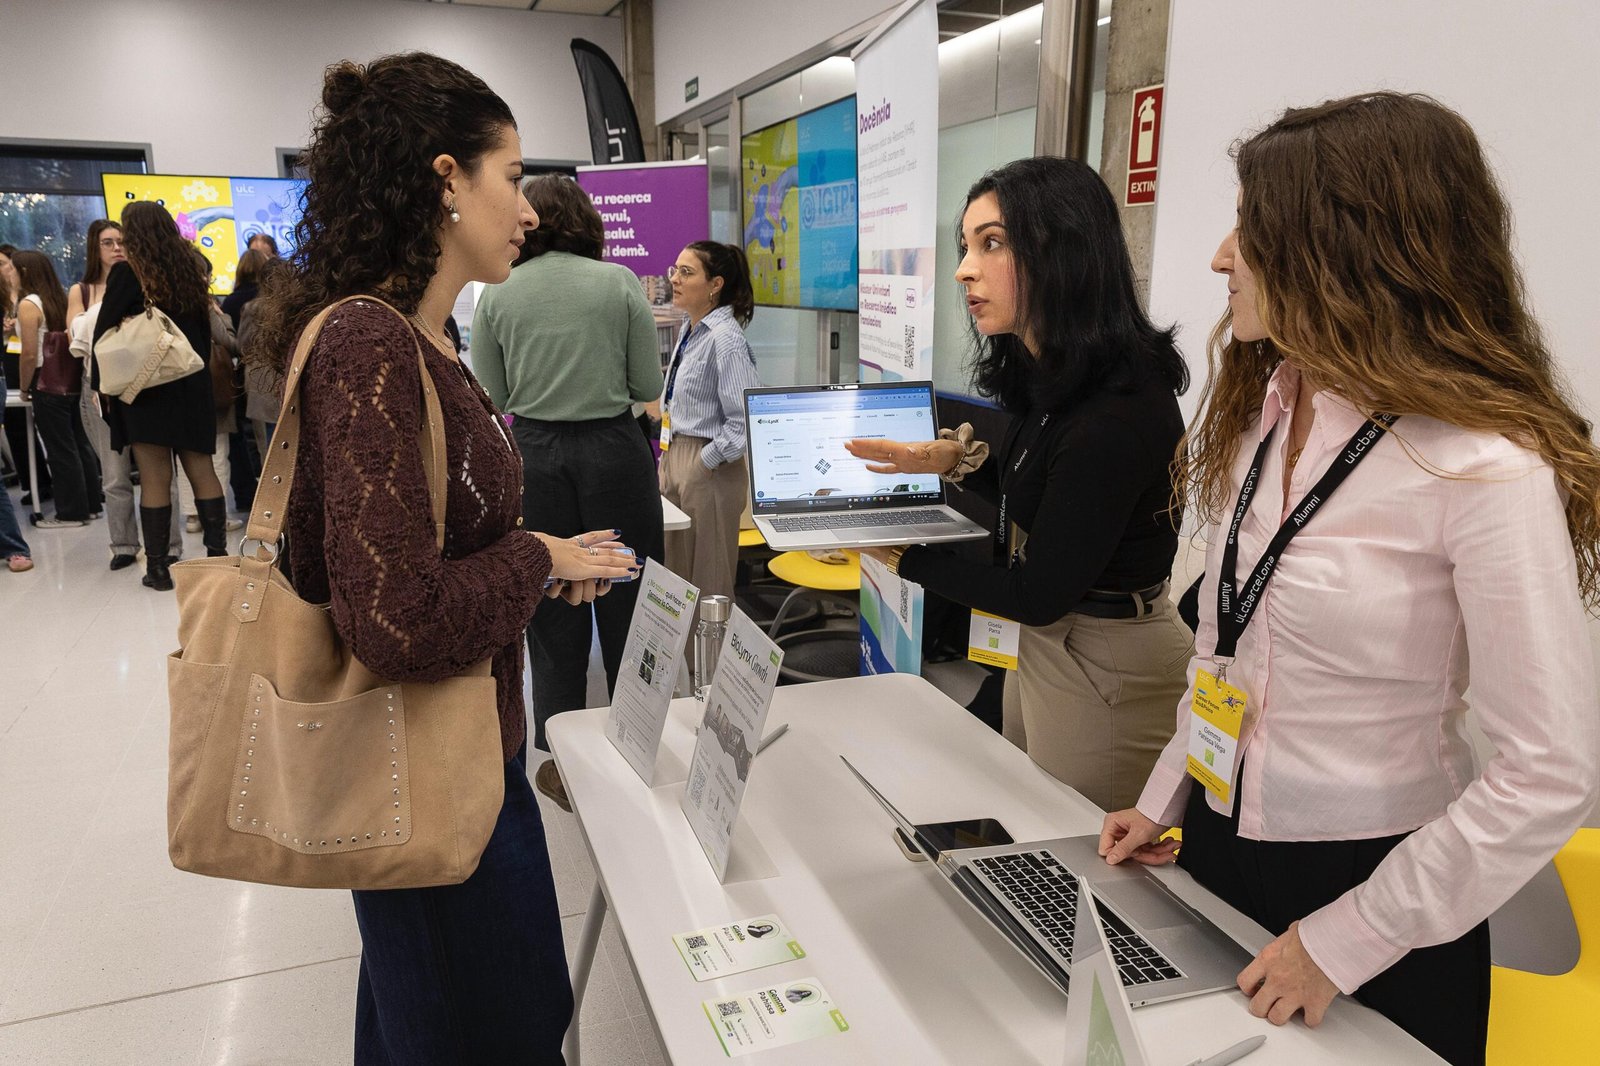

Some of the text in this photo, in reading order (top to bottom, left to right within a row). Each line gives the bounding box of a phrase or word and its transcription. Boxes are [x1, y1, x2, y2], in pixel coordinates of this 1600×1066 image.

[860, 97, 891, 135] Docència
[235, 184, 255, 194] uic
[604, 193, 652, 205] recerca
[1130, 180, 1156, 194] EXTIN
[818, 185, 849, 214] IGTP
[597, 208, 632, 225] 'avui,
[603, 227, 635, 240] salut
[612, 243, 650, 257] demà.
[1345, 412, 1393, 464] uicbare
[1014, 448, 1028, 472] Alumni
[1228, 467, 1258, 545] uicbarcelona
[1293, 495, 1321, 527] Alumni
[1221, 581, 1231, 613] Alumni
[1236, 555, 1275, 624] uicbarcelona
[730, 632, 753, 666] BioLynx
[750, 653, 769, 684] Growth
[1203, 726, 1222, 743] Gemma
[1214, 740, 1226, 754] Vega
[758, 991, 776, 1015] Pahissa
[769, 989, 787, 1013] Gemma
